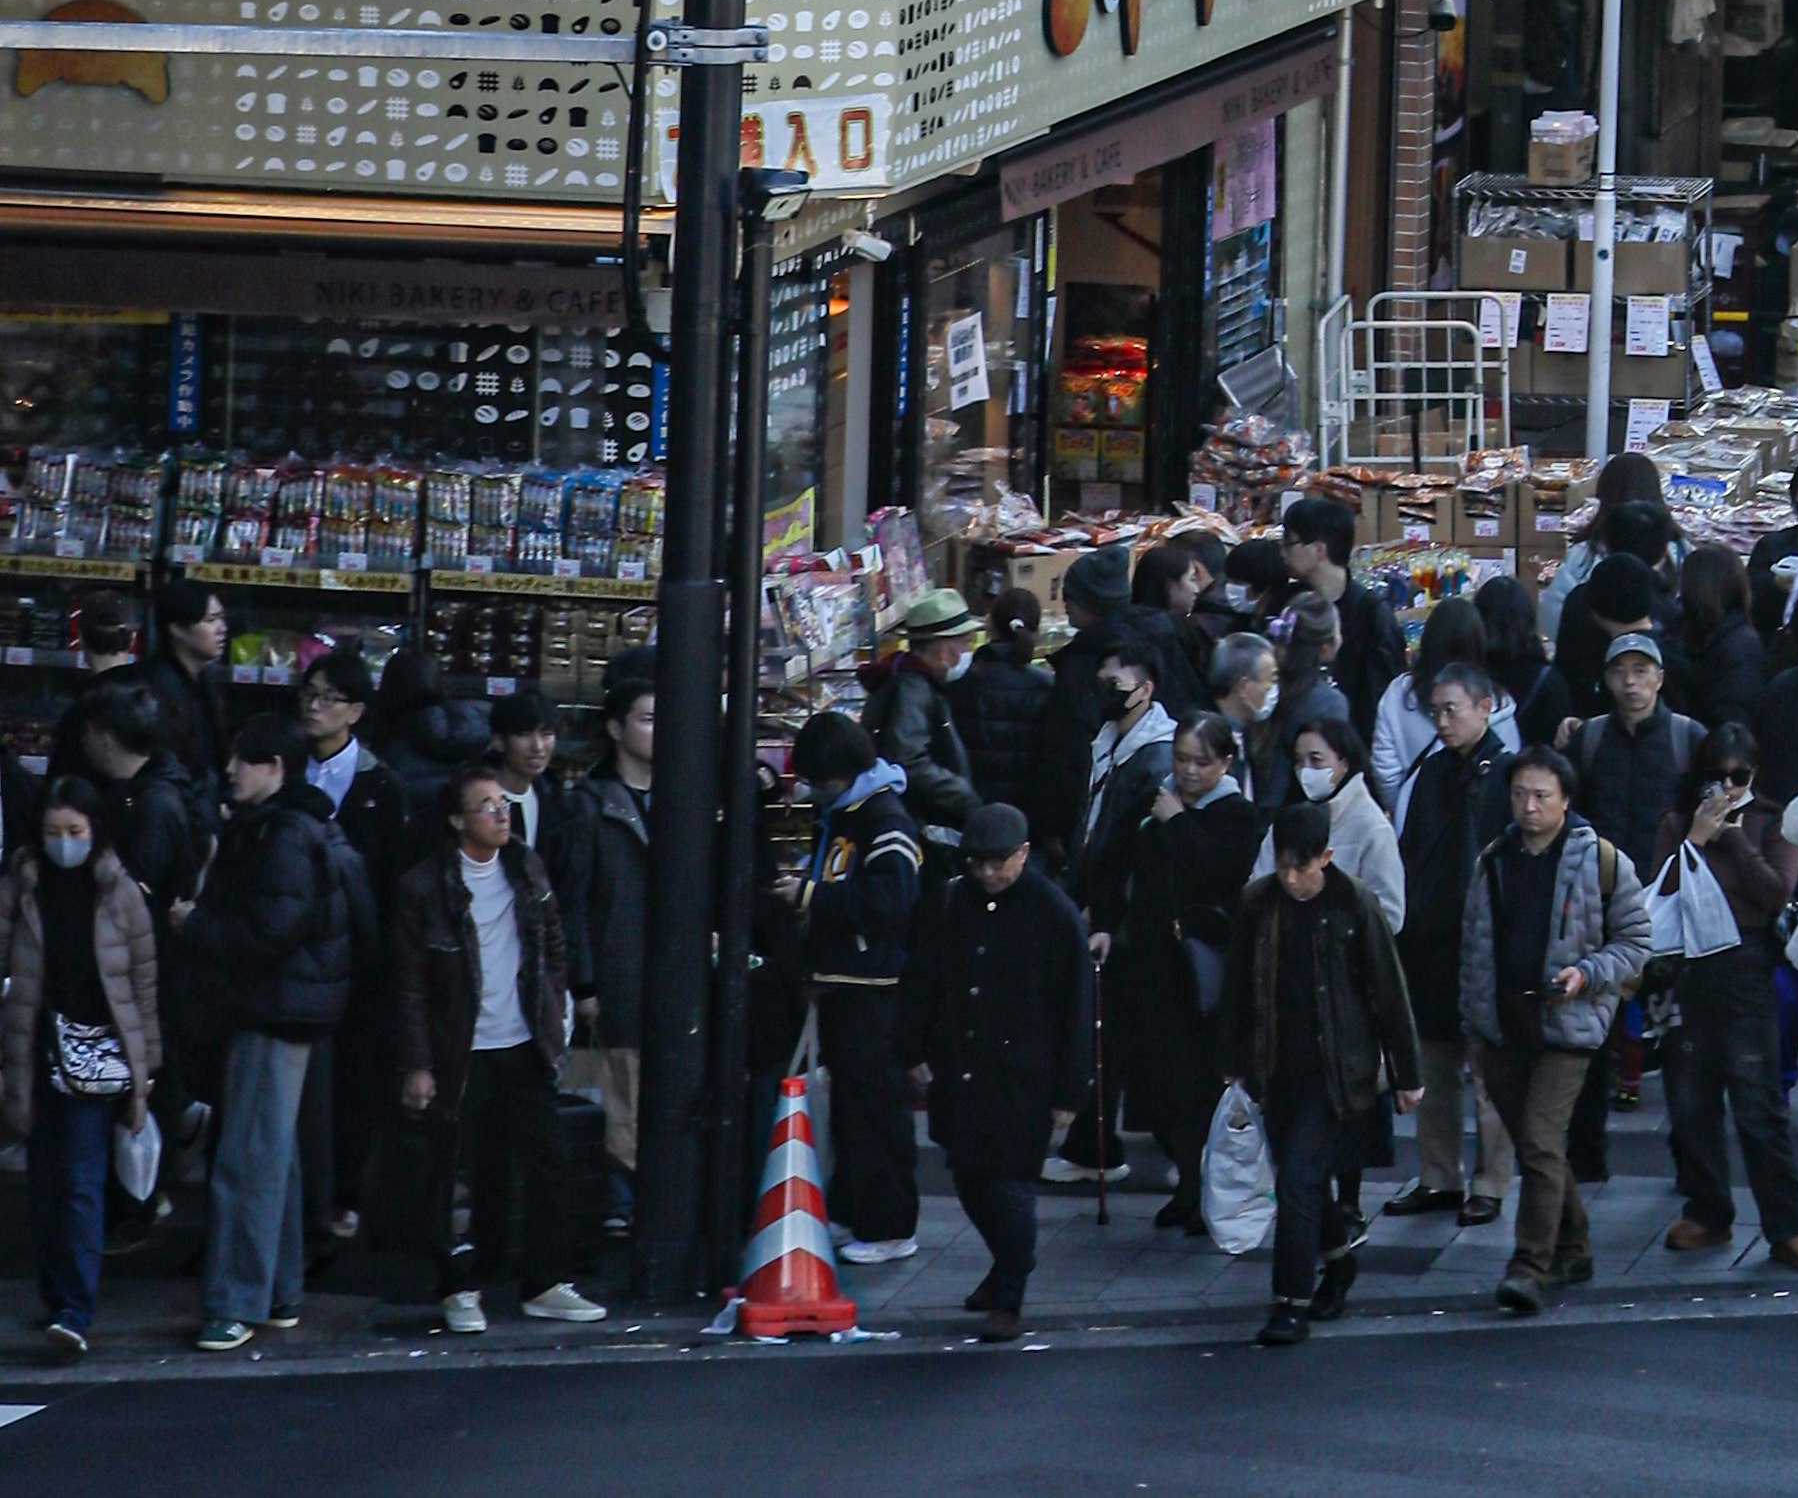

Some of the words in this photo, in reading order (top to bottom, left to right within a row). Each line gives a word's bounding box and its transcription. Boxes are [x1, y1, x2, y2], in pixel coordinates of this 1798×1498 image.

[315, 281, 377, 303] NIKI
[387, 283, 504, 310] BAKERY
[515, 288, 534, 312] &
[546, 289, 622, 315] CAFE
